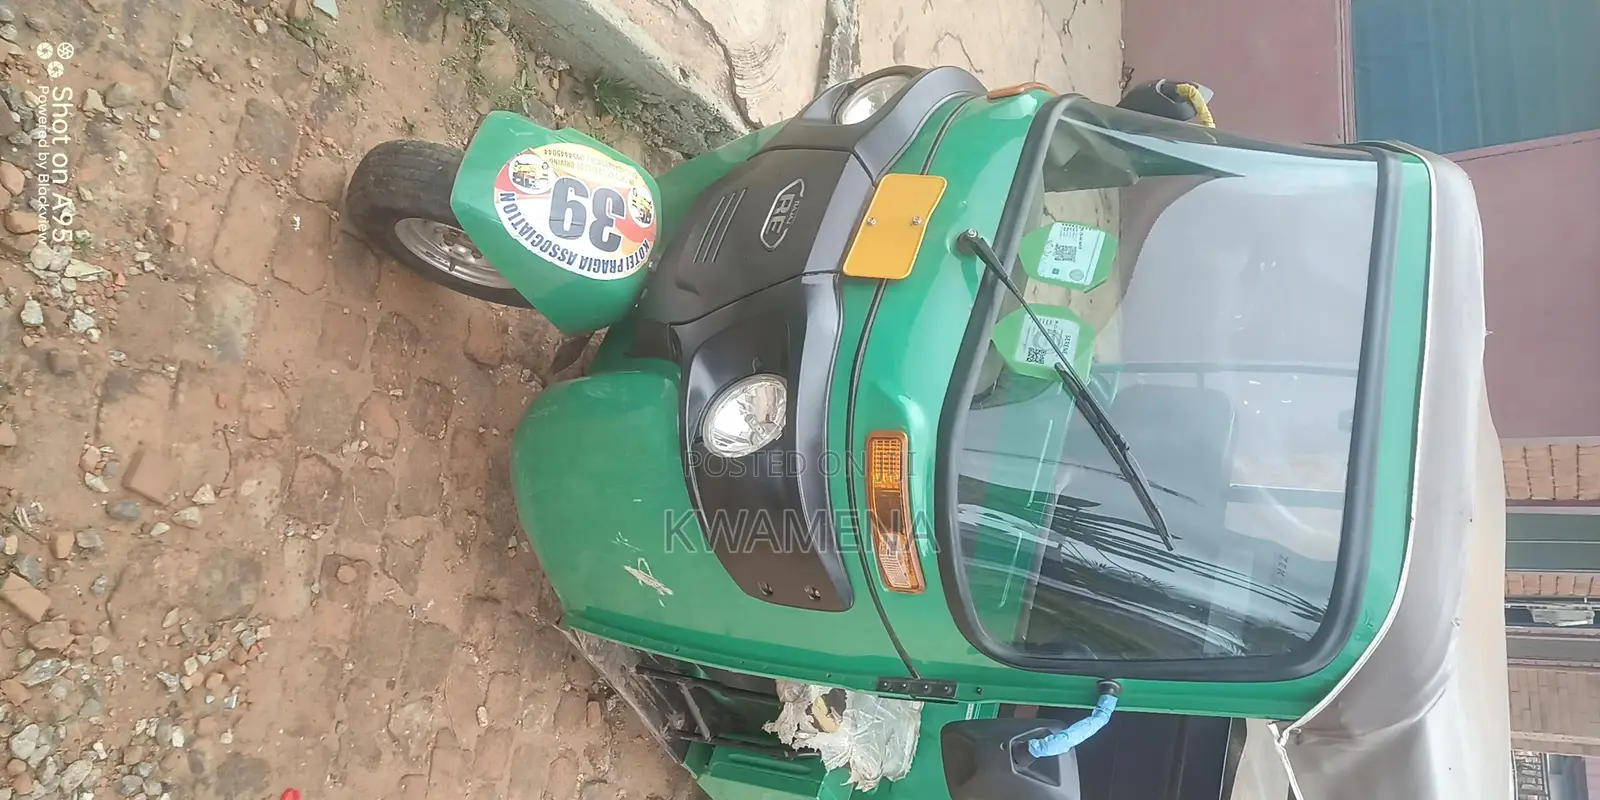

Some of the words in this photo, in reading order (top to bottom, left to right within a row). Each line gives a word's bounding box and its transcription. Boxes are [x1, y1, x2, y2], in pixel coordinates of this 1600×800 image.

[549, 158, 575, 168] DRIVING
[500, 192, 578, 266] ASSOCIATION
[549, 177, 625, 252] 39
[765, 194, 796, 235] RE
[579, 256, 624, 274] PRAGIA
[626, 240, 650, 271] KOTEI
